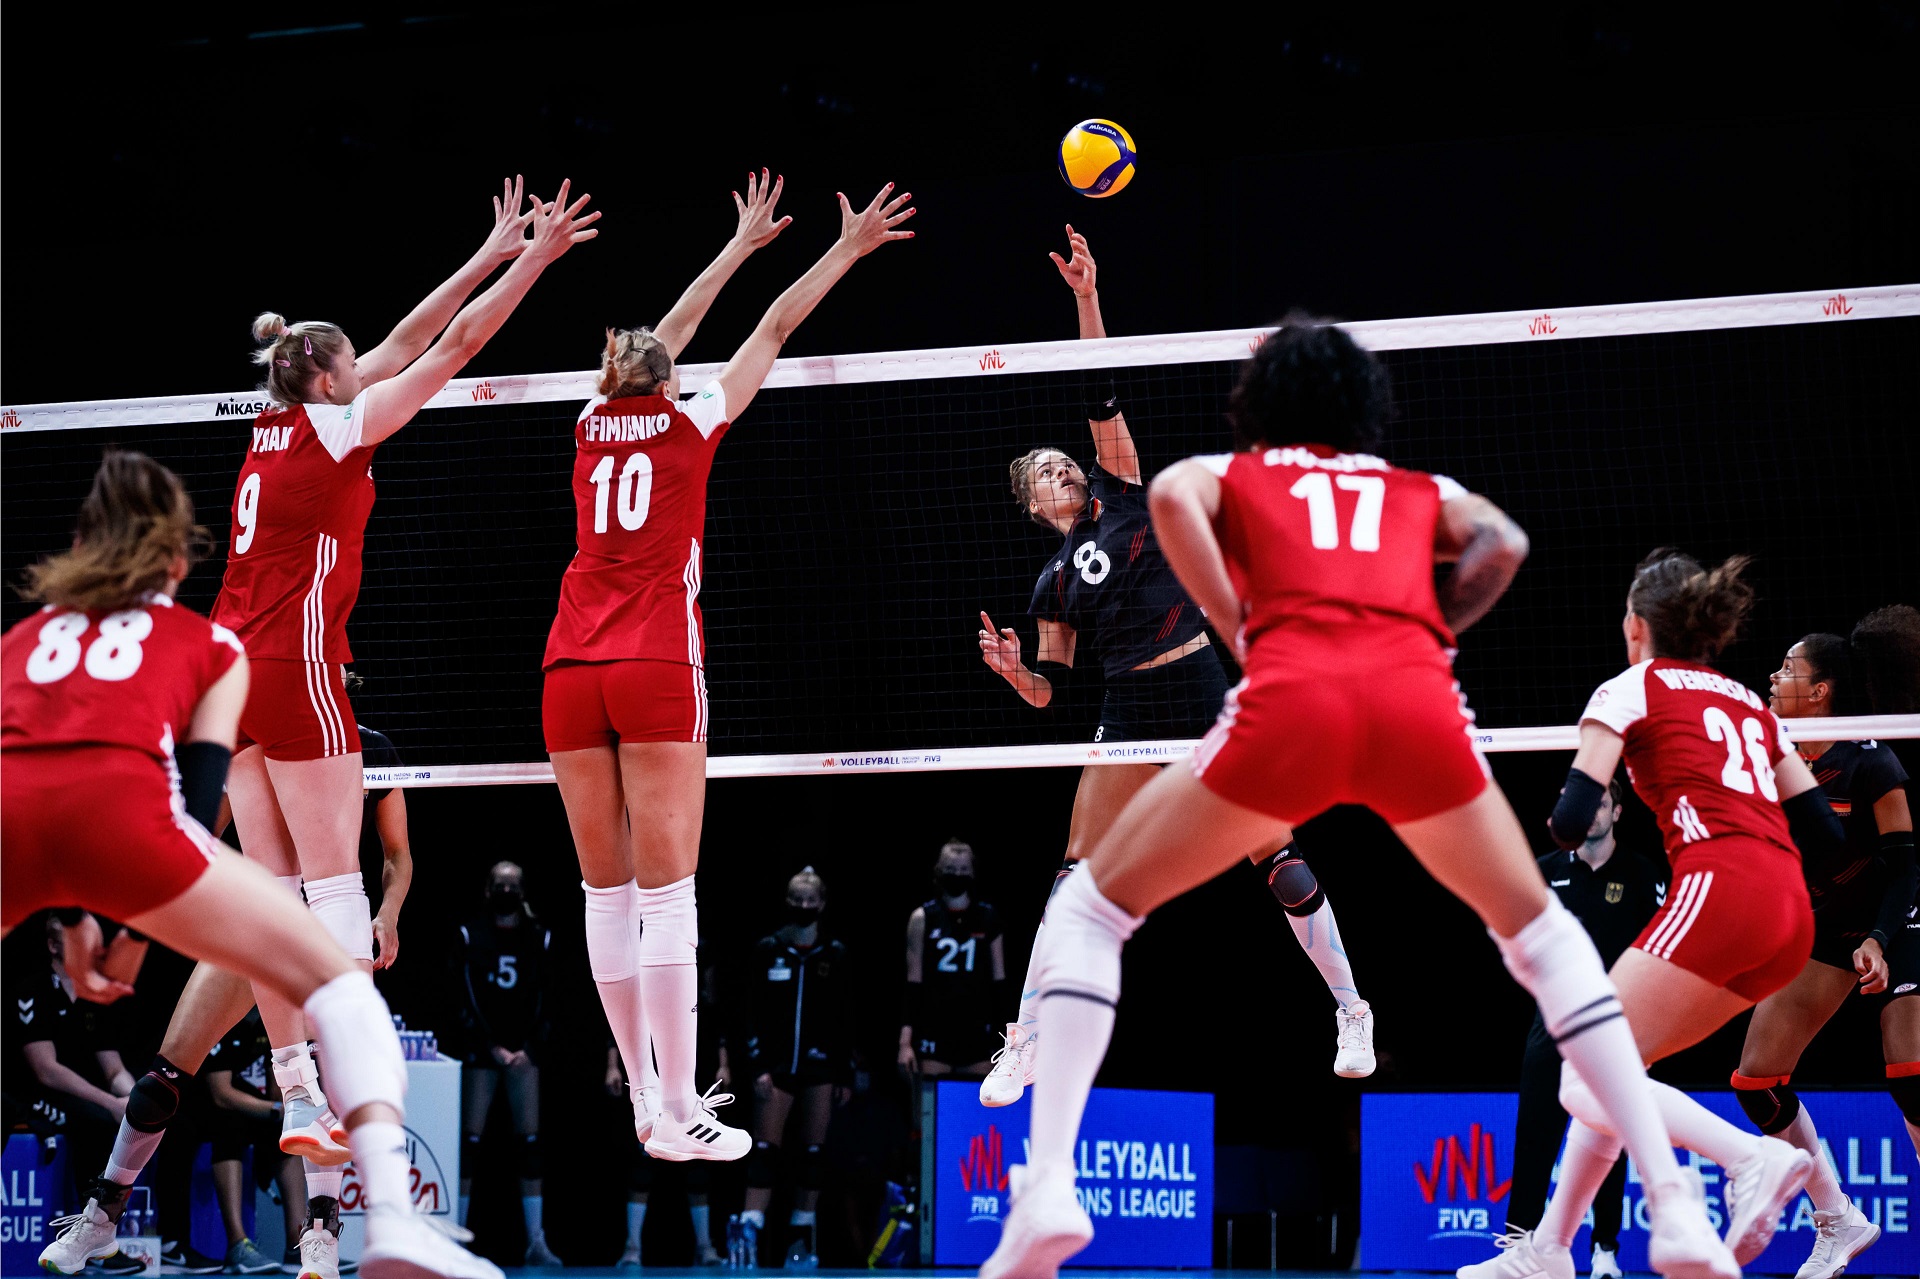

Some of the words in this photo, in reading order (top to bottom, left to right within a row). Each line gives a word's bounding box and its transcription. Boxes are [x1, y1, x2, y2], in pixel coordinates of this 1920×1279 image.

[1822, 293, 1853, 316] VNL
[1248, 332, 1269, 353] VN
[1528, 313, 1558, 336] VNL
[978, 349, 1006, 371] VNL
[471, 381, 497, 402] VNL
[589, 452, 653, 534] 10
[235, 472, 261, 555] 9
[1289, 471, 1386, 552] 17
[1073, 540, 1111, 585] 8
[25, 609, 154, 685] 88
[1094, 725, 1104, 742] 8
[840, 756, 900, 767] VOLLEYBALL
[1107, 747, 1168, 757] VOLLEYBALL
[1702, 706, 1779, 803] 26
[362, 773, 392, 782] YBALL
[496, 954, 518, 990] 5
[935, 936, 977, 973] 21
[959, 1123, 1010, 1192] VNL
[1022, 1137, 1196, 1182] LEYBALL
[1413, 1123, 1513, 1204] VNL
[1119, 1188, 1196, 1219] LEAGUE
